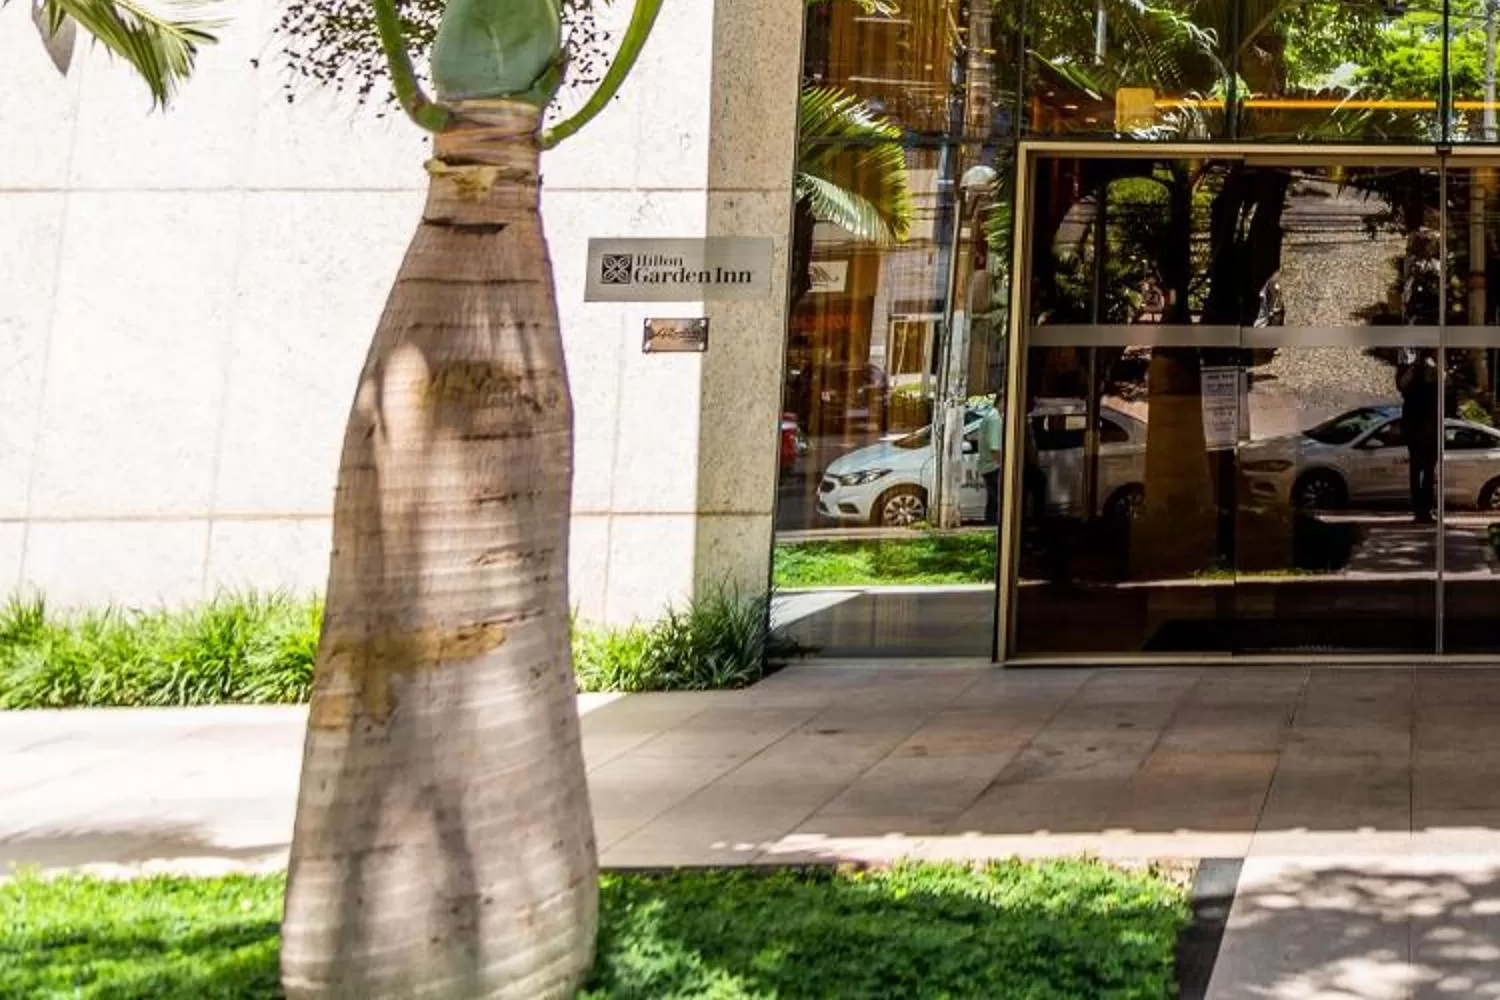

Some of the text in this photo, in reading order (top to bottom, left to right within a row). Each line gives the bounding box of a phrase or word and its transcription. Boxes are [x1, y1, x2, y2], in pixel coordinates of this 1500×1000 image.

[635, 254, 684, 267] Hilton
[634, 266, 752, 284] Garden Inn
